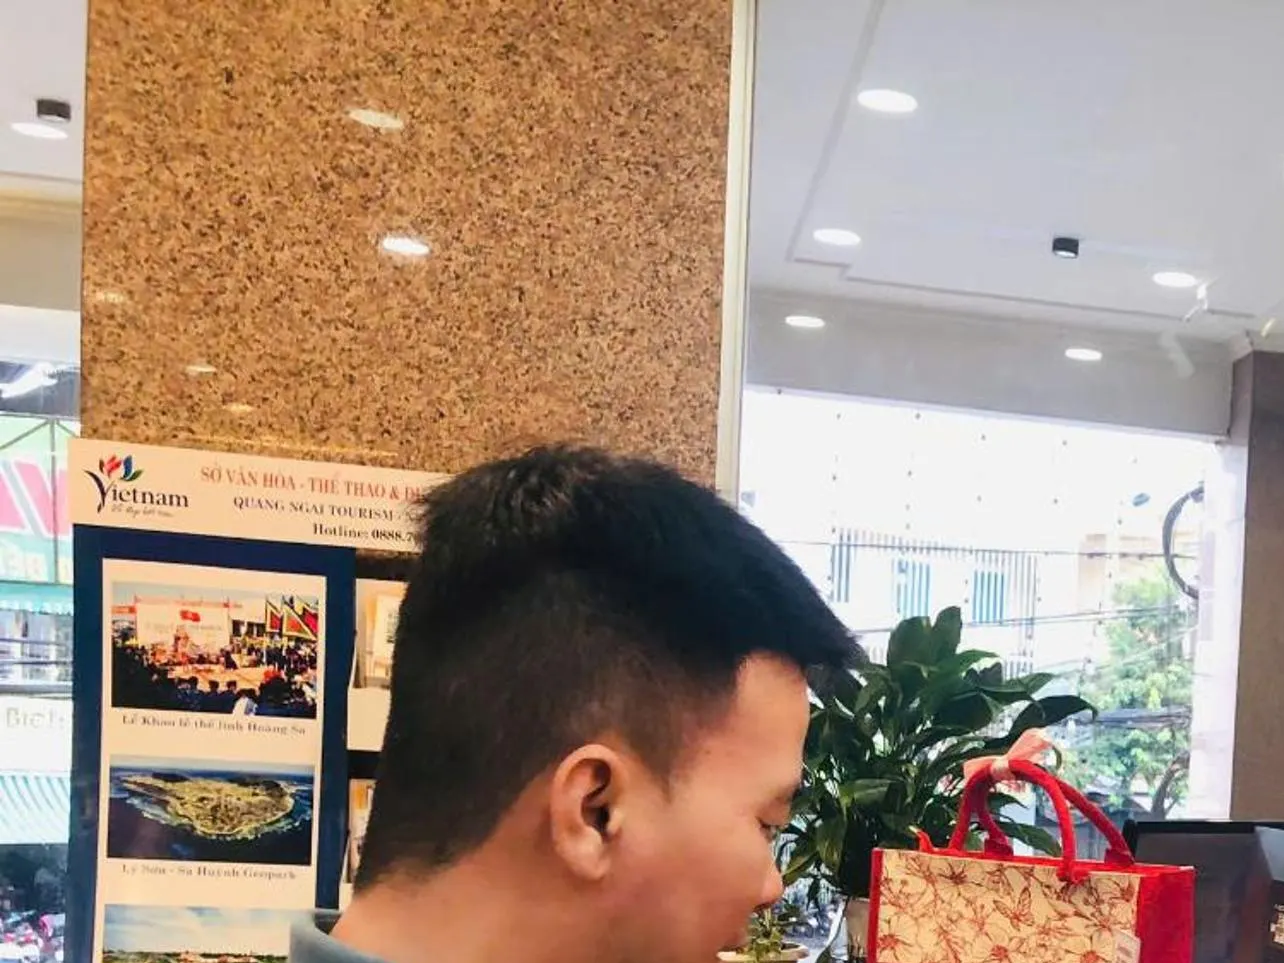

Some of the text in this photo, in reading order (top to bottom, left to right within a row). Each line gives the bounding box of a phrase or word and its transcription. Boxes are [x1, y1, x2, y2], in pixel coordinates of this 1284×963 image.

[84, 469, 189, 513] Vietnam
[345, 480, 386, 499] THAO
[389, 484, 400, 501] &
[328, 504, 393, 522] TOURISM
[313, 522, 418, 544] Hotline: 0888.7
